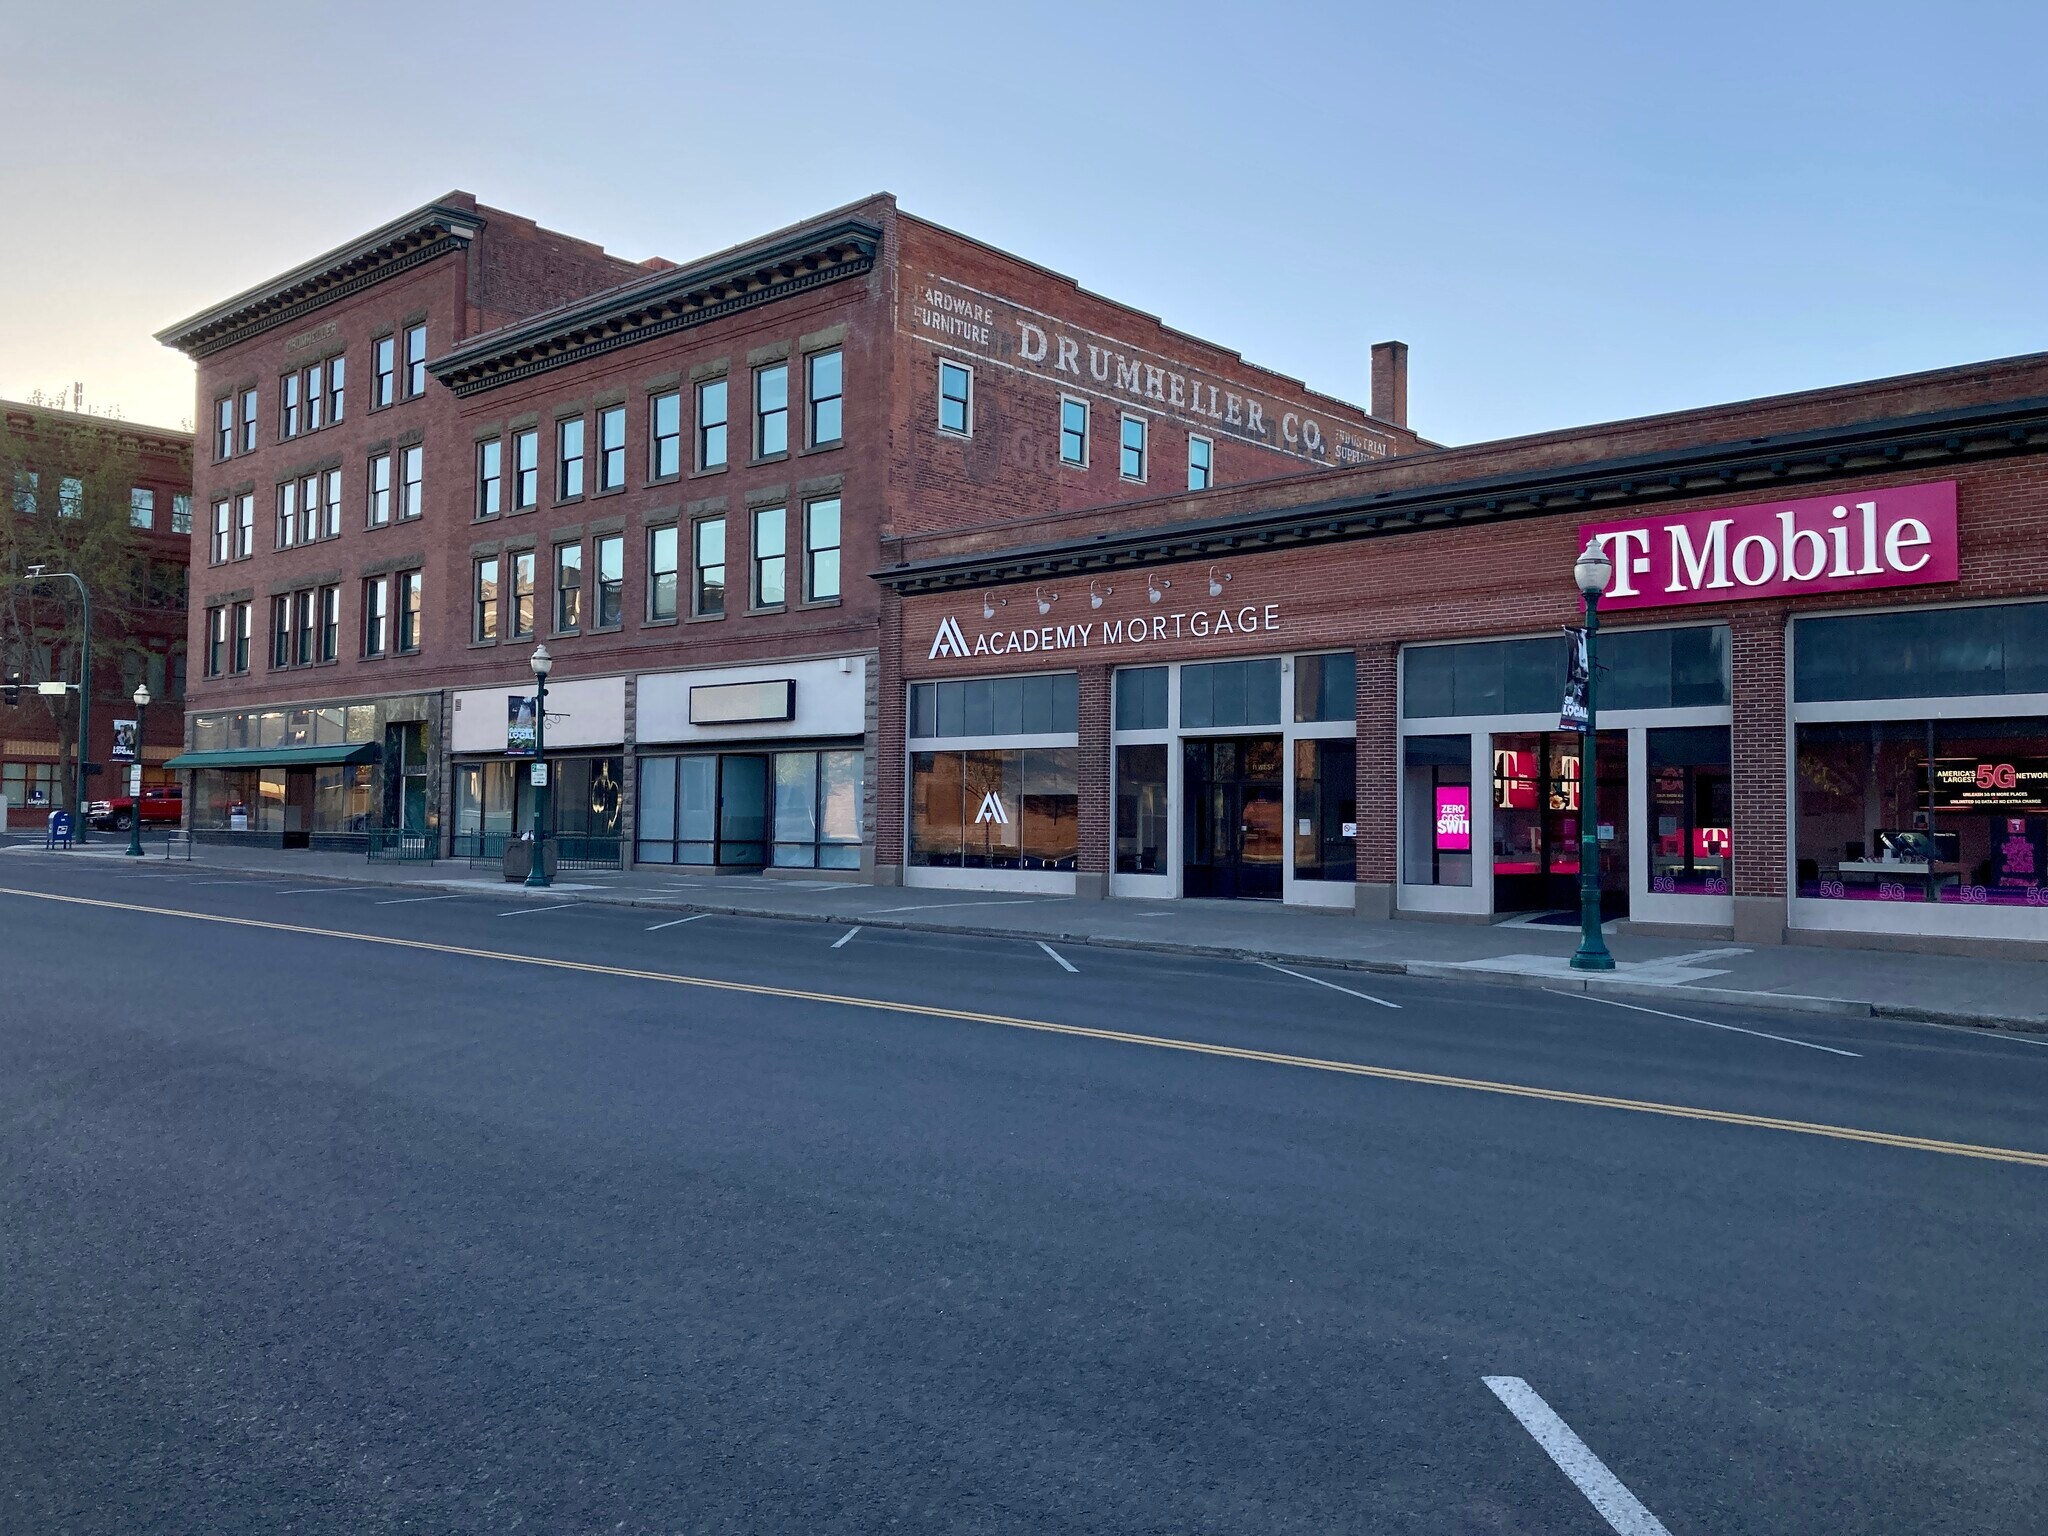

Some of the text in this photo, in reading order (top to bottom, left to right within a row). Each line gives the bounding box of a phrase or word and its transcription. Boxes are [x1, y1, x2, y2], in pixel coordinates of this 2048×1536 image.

[1016, 319, 1325, 455] DRUMHELLER CO.
[973, 604, 1281, 656] ACADEMY MORTGAGE
[1562, 704, 1588, 719] LOCAL
[1976, 763, 2016, 789] 5G
[1440, 804, 1466, 814] ZERO
[1441, 814, 1466, 822] COST
[1653, 876, 1675, 892] 5G
[1704, 877, 1727, 893] 5G
[1820, 880, 1845, 898] 5G
[1879, 882, 1906, 899] 5G
[1960, 886, 1987, 901] 5G
